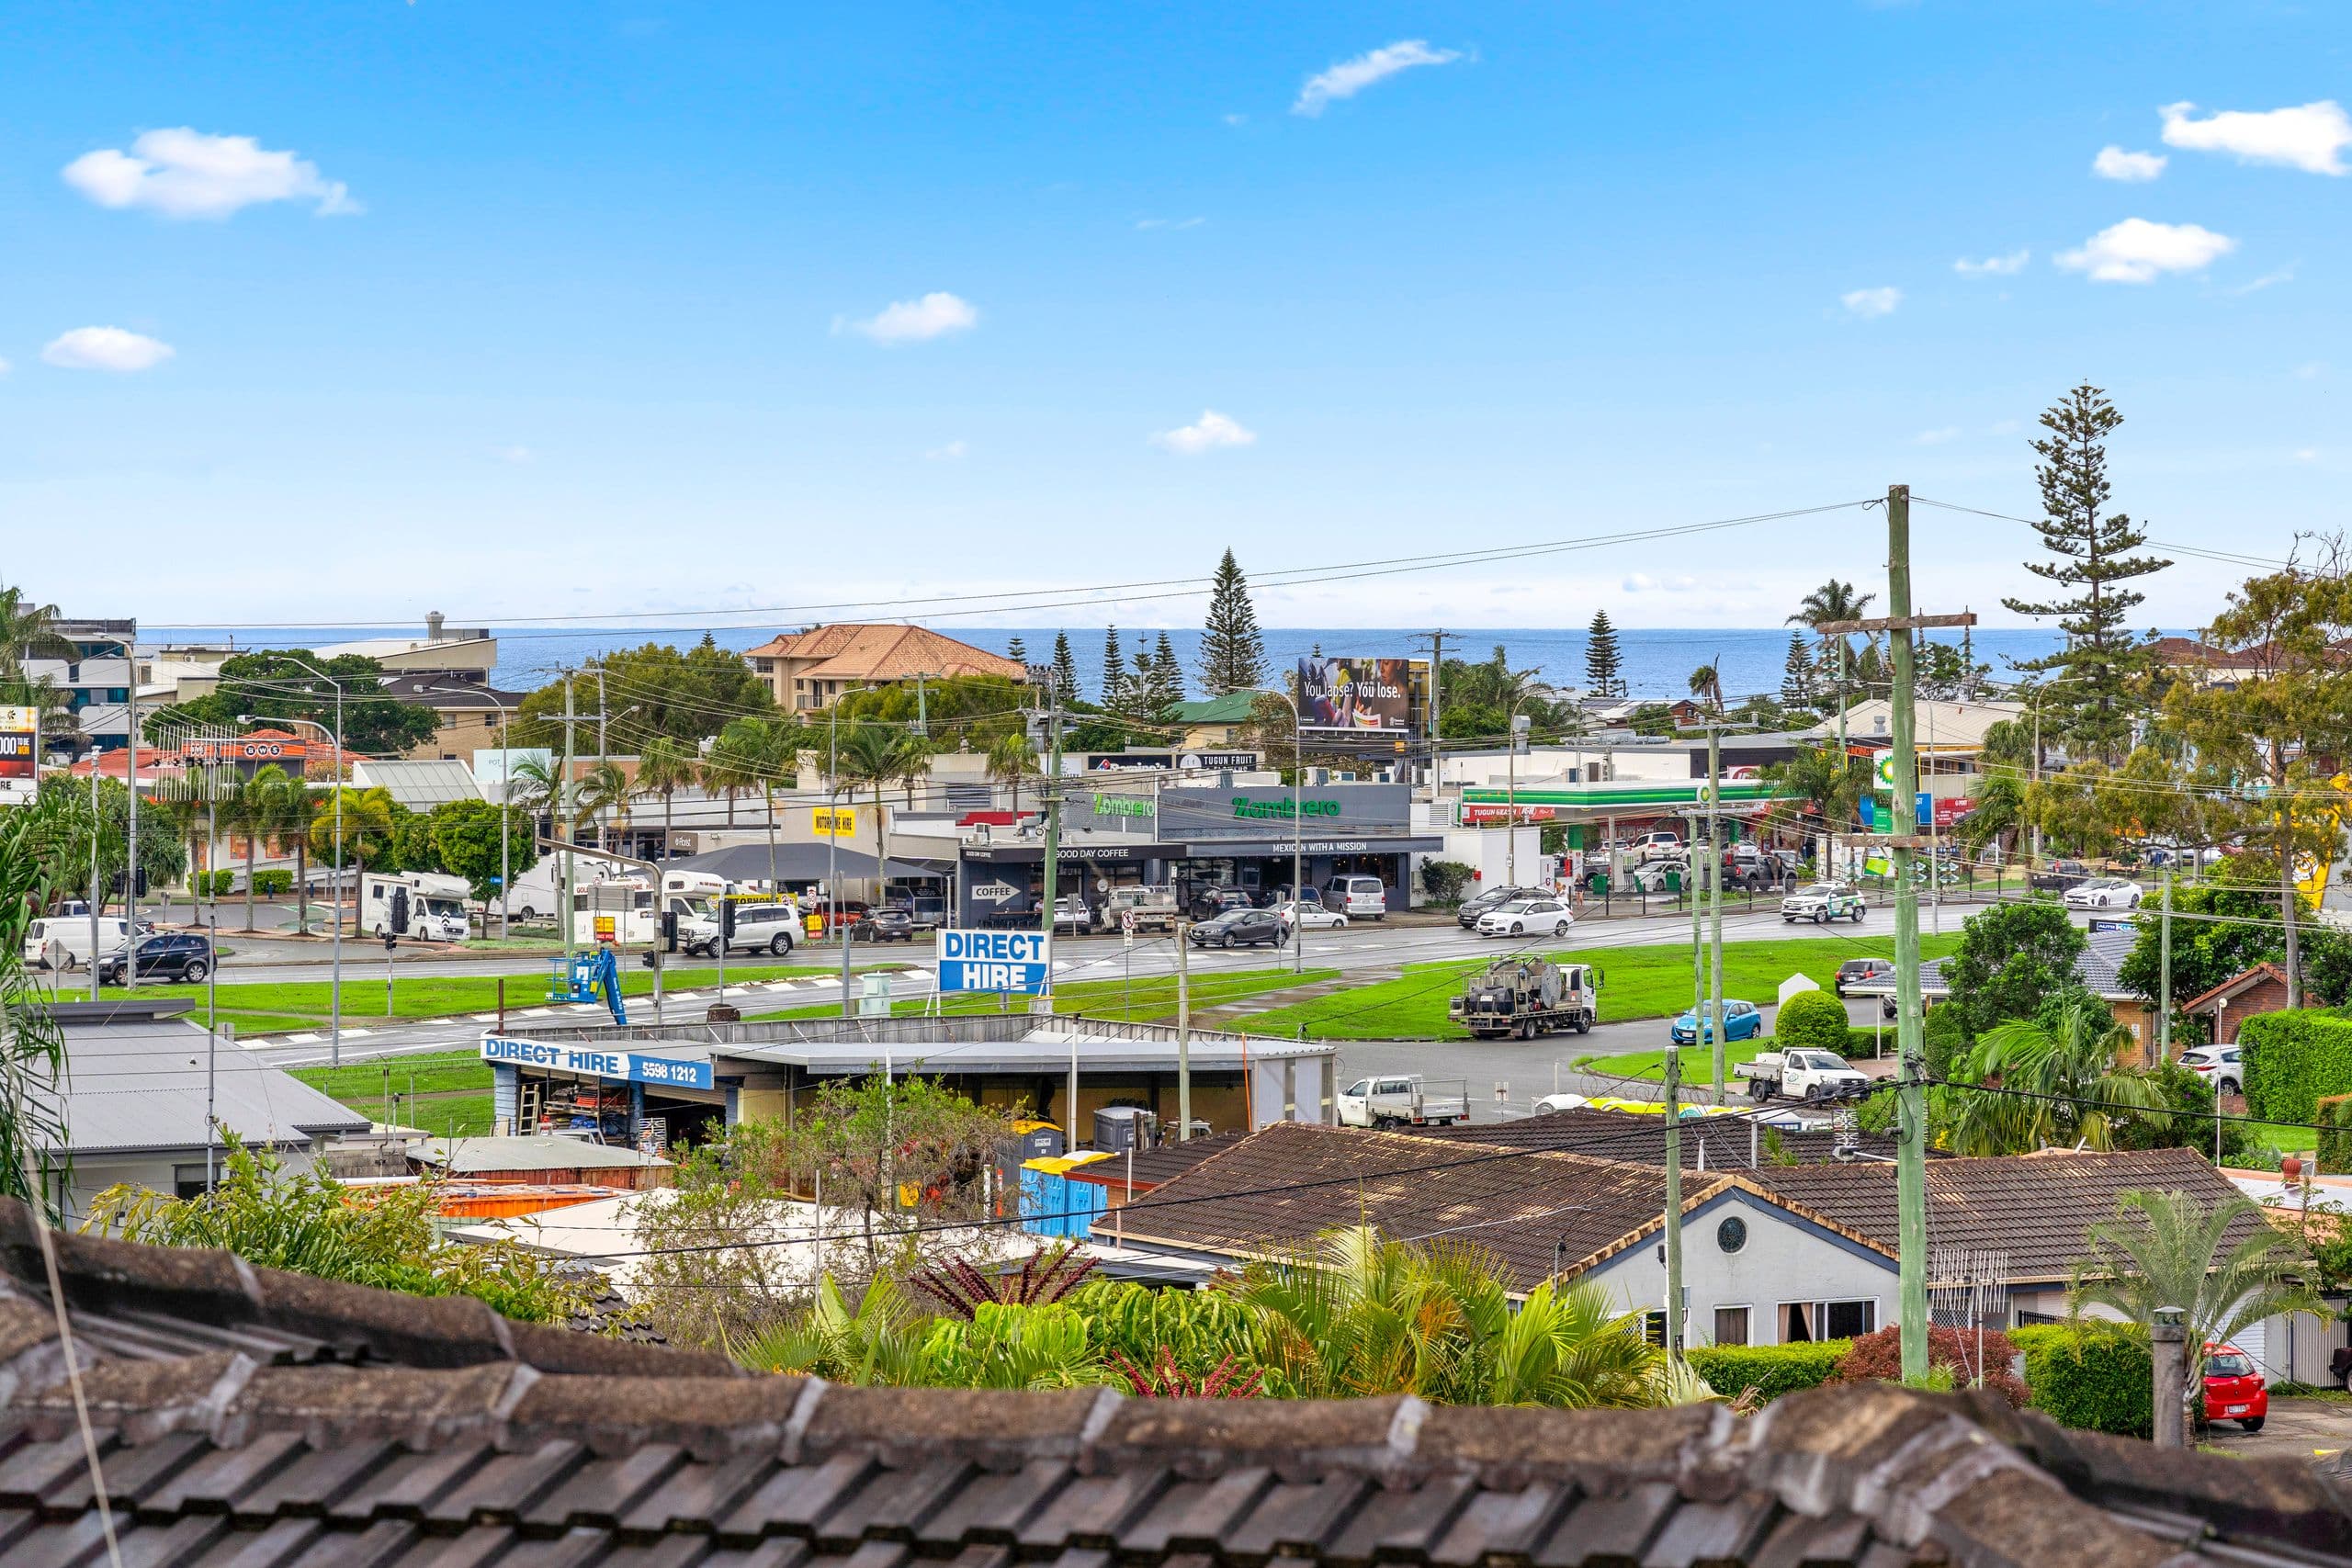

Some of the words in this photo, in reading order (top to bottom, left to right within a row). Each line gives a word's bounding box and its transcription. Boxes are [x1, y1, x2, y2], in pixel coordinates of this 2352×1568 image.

[1305, 682, 1321, 697] You
[1325, 682, 1354, 698] lapse?
[1356, 682, 1374, 698] You
[1377, 682, 1401, 698] lose.
[247, 744, 279, 755] BWS
[1204, 756, 1228, 765] TUGUN
[1232, 756, 1253, 764] FRUIT
[1232, 796, 1341, 818] Zambrero
[815, 816, 841, 830] MOTORHME
[1080, 850, 1096, 858] DAY
[1097, 849, 1129, 858] COFFEE
[1272, 842, 1306, 852] MEXICN
[1308, 842, 1328, 852] WITH
[1336, 841, 1367, 852] MISSION
[976, 887, 1011, 897] COFFEE
[945, 932, 1045, 960] DIRECT
[962, 963, 1026, 991] HIRE
[486, 1038, 561, 1065] DIRECT
[568, 1050, 619, 1075] HIRE
[642, 1061, 668, 1079] 5598
[670, 1065, 697, 1083] 1212
